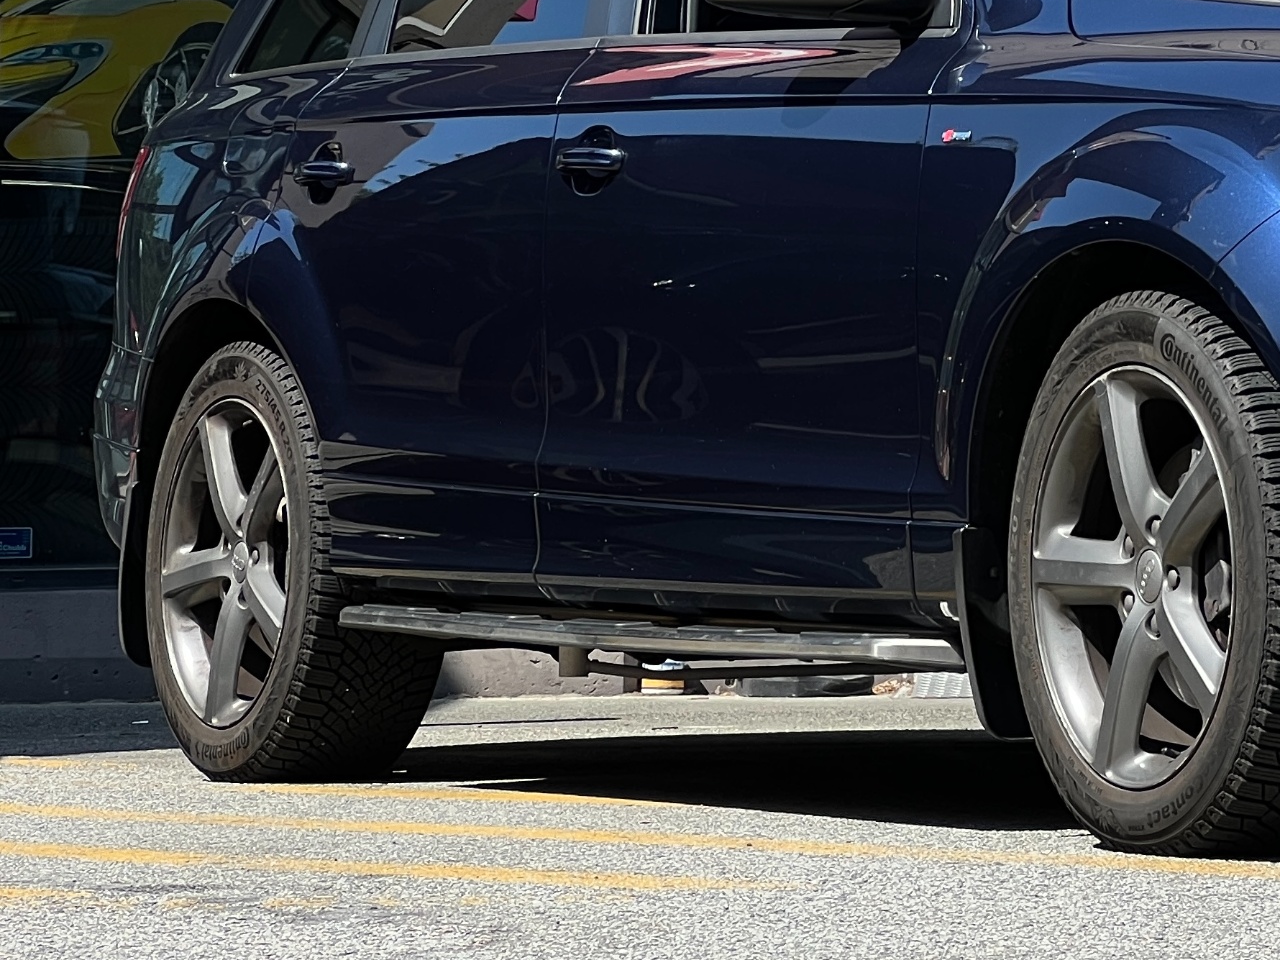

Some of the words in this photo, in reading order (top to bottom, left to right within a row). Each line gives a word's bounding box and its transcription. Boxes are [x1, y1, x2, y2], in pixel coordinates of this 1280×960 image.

[254, 378, 282, 423] 275/45
[1159, 332, 1229, 433] Continental
[201, 727, 250, 761] Continental
